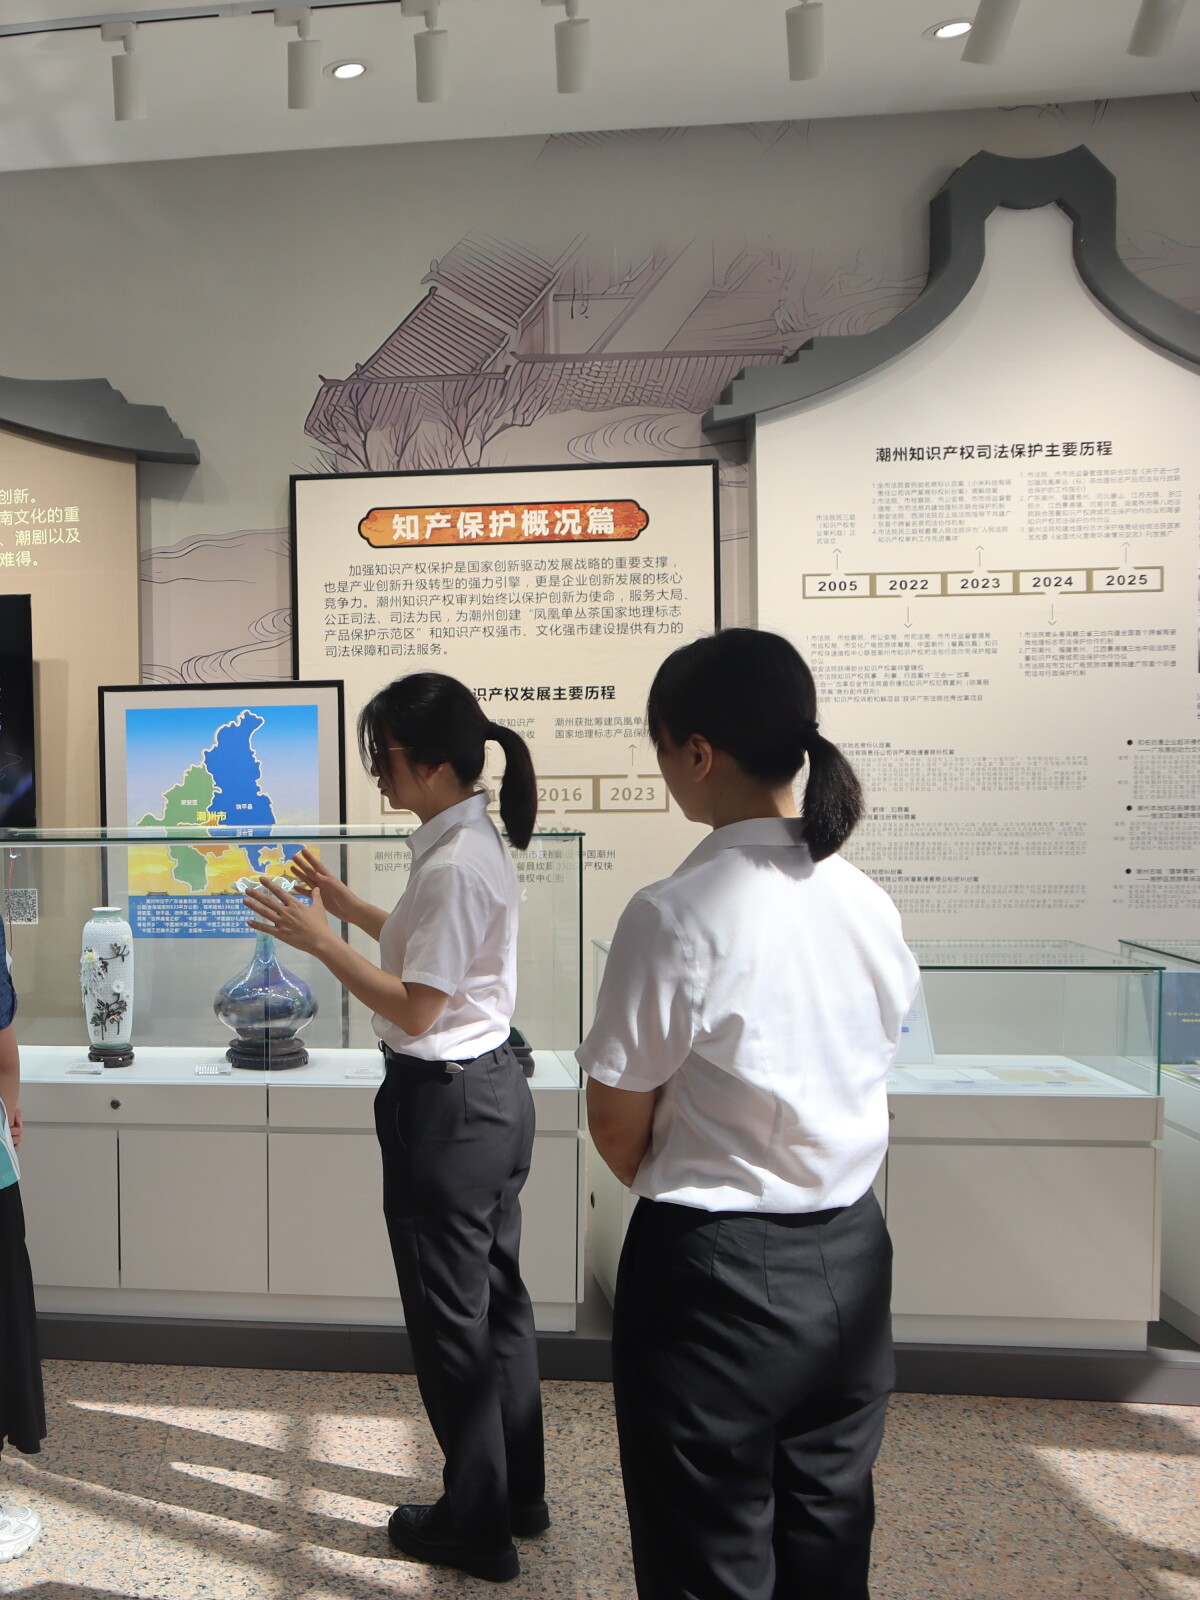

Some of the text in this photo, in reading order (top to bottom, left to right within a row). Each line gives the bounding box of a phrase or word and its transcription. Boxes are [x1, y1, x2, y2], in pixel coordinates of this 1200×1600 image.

[875, 441, 1113, 463] 潮州知识产权司法保护主要历程
[392, 507, 616, 540] 知产保护概况篇
[348, 555, 677, 577] 加强知识产权保护是国家创新驱动发展战略的重要支撑，
[324, 571, 683, 594] 也是产业创新升级转型的强力引擎，更是企业创新发展的核心
[818, 573, 1148, 593] 2005 2022 2023 2024 2025
[324, 588, 689, 610] 竞争力。潮州知识产权审判始终以保护创新为使命，服务大局、
[325, 642, 449, 658] 司法保障和司法服务。
[555, 716, 646, 728] 潮州获批筹建凤凰单
[538, 787, 655, 801] 2016 2023
